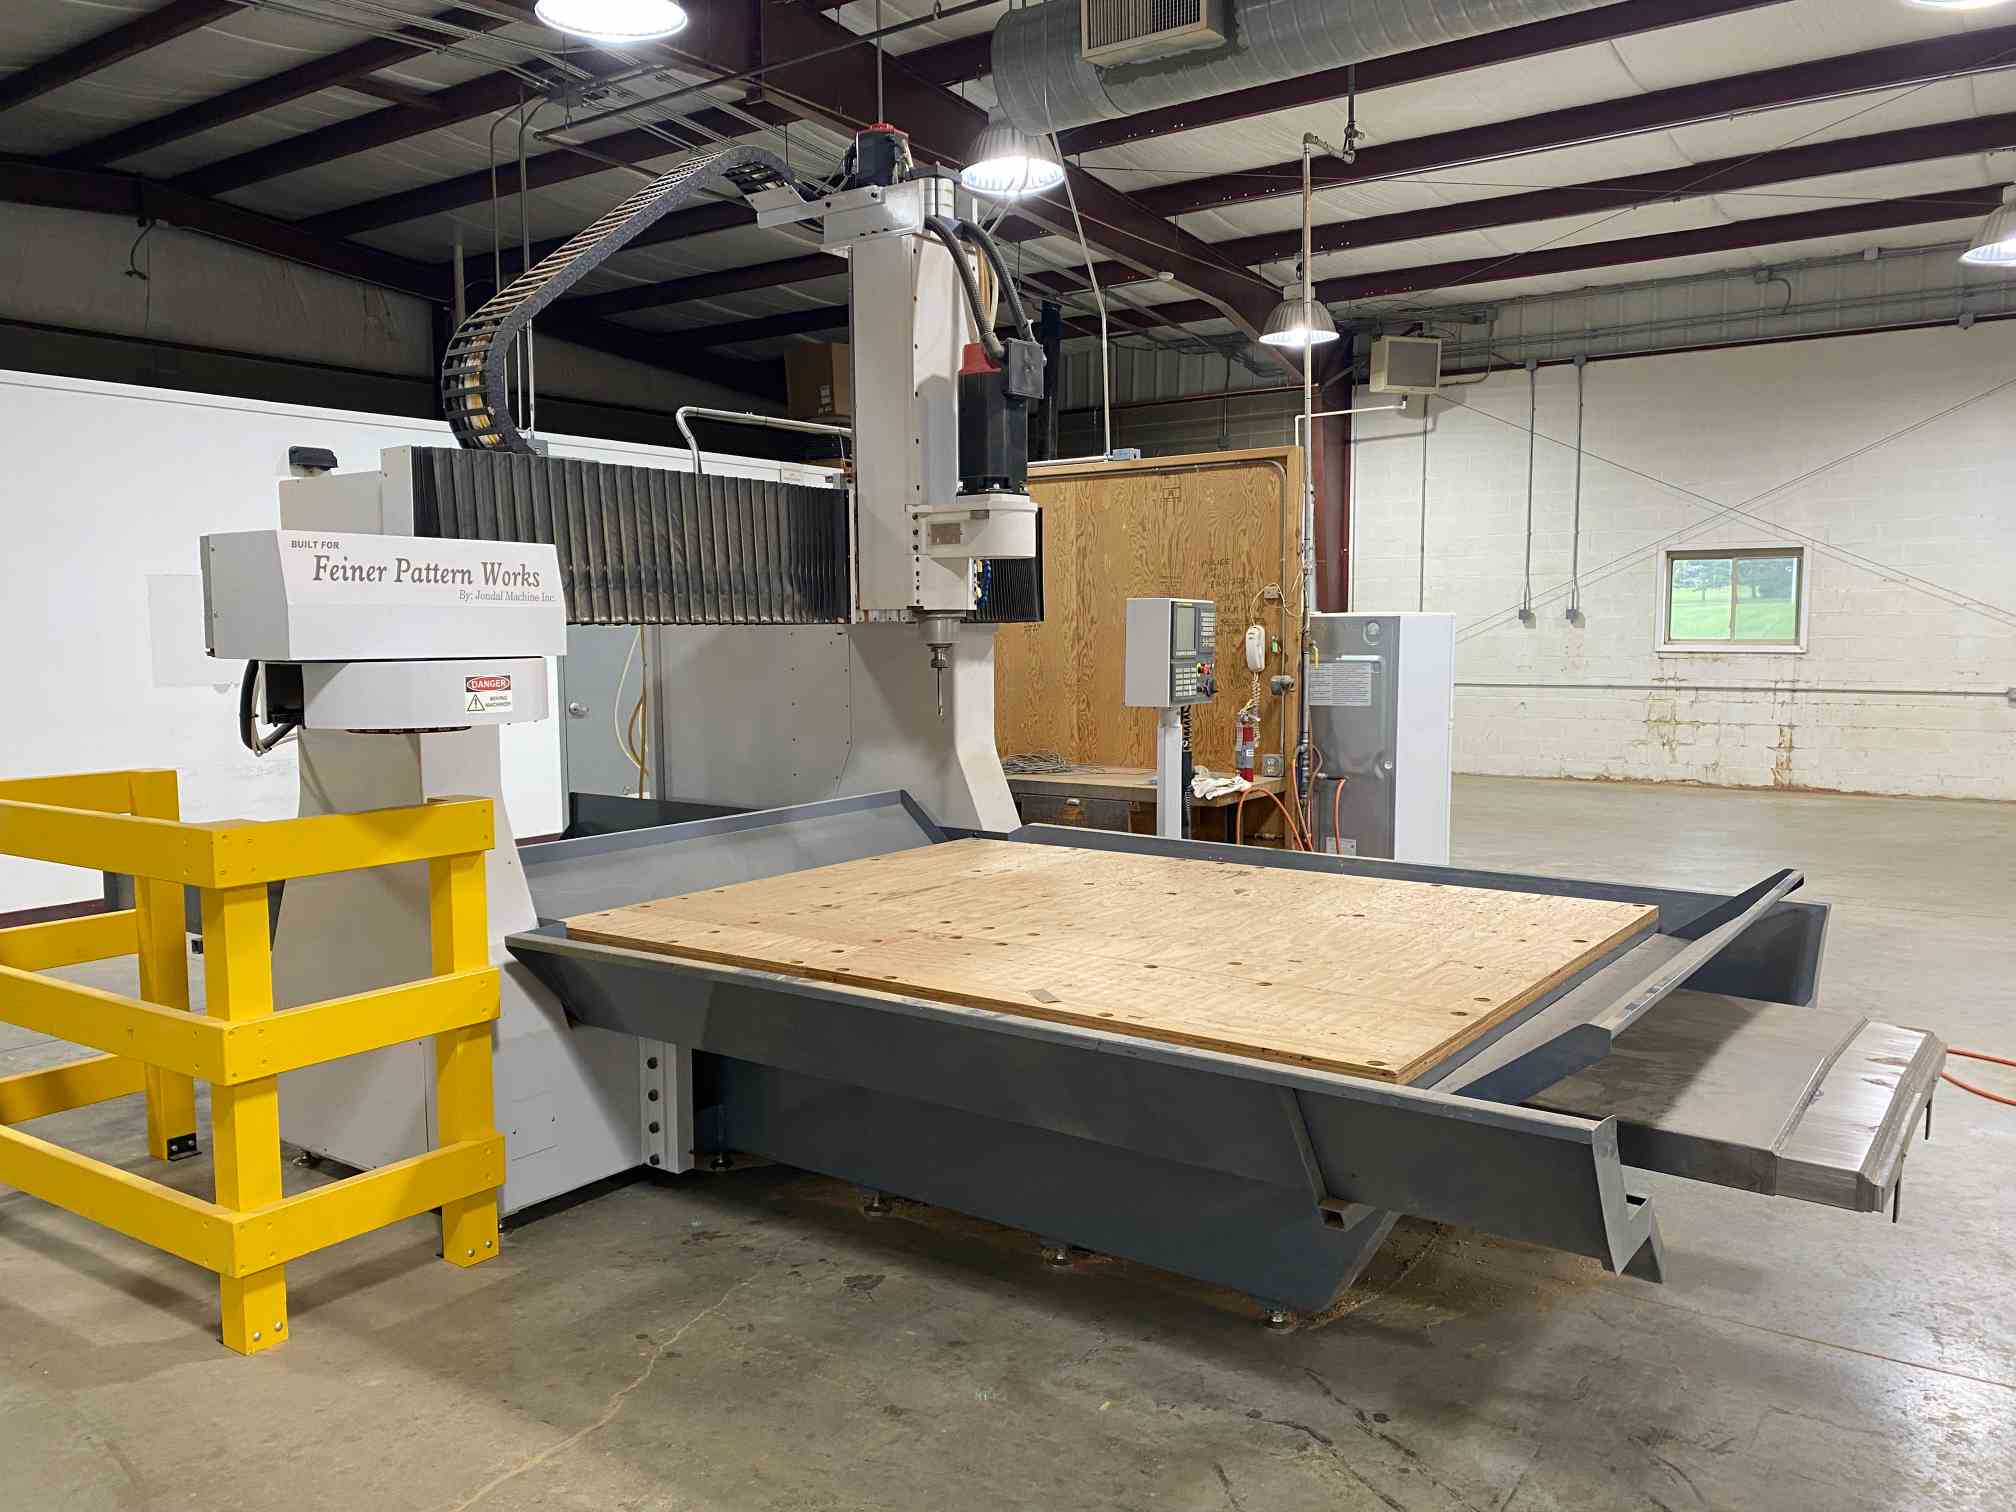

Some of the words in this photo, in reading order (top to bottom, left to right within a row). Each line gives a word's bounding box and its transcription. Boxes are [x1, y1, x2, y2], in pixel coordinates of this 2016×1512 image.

[291, 540, 318, 549] BUILT
[321, 541, 340, 549] FOR
[312, 554, 388, 583] Feiner
[393, 557, 473, 585] Pattern
[481, 561, 541, 588] Works
[505, 591, 539, 602] Machine
[471, 679, 506, 689] DANGER
